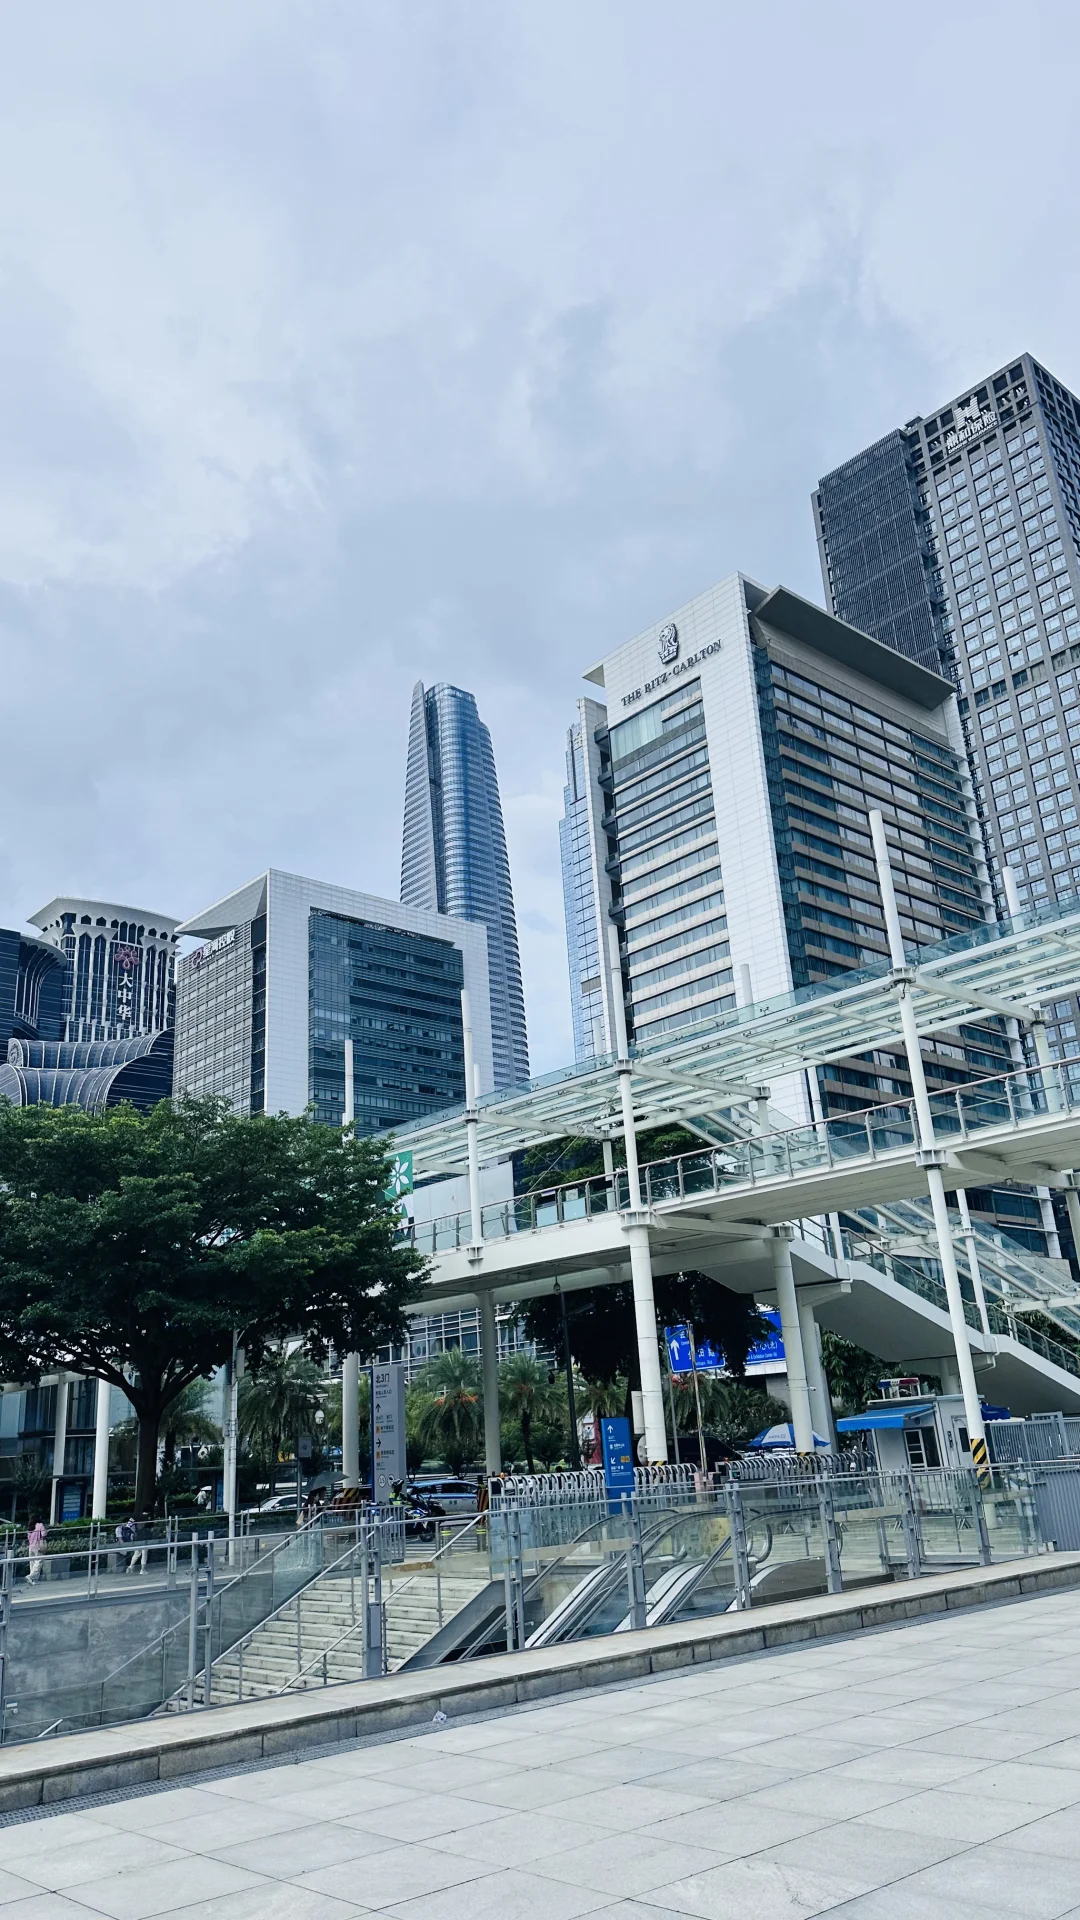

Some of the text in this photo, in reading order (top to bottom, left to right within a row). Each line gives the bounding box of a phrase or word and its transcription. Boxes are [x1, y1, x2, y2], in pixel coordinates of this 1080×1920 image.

[946, 411, 997, 450] 鼎和保险
[621, 639, 722, 706] THE RITZ-CARLTON
[117, 972, 133, 1021] 大中华
[376, 1373, 390, 1383] 北3门
